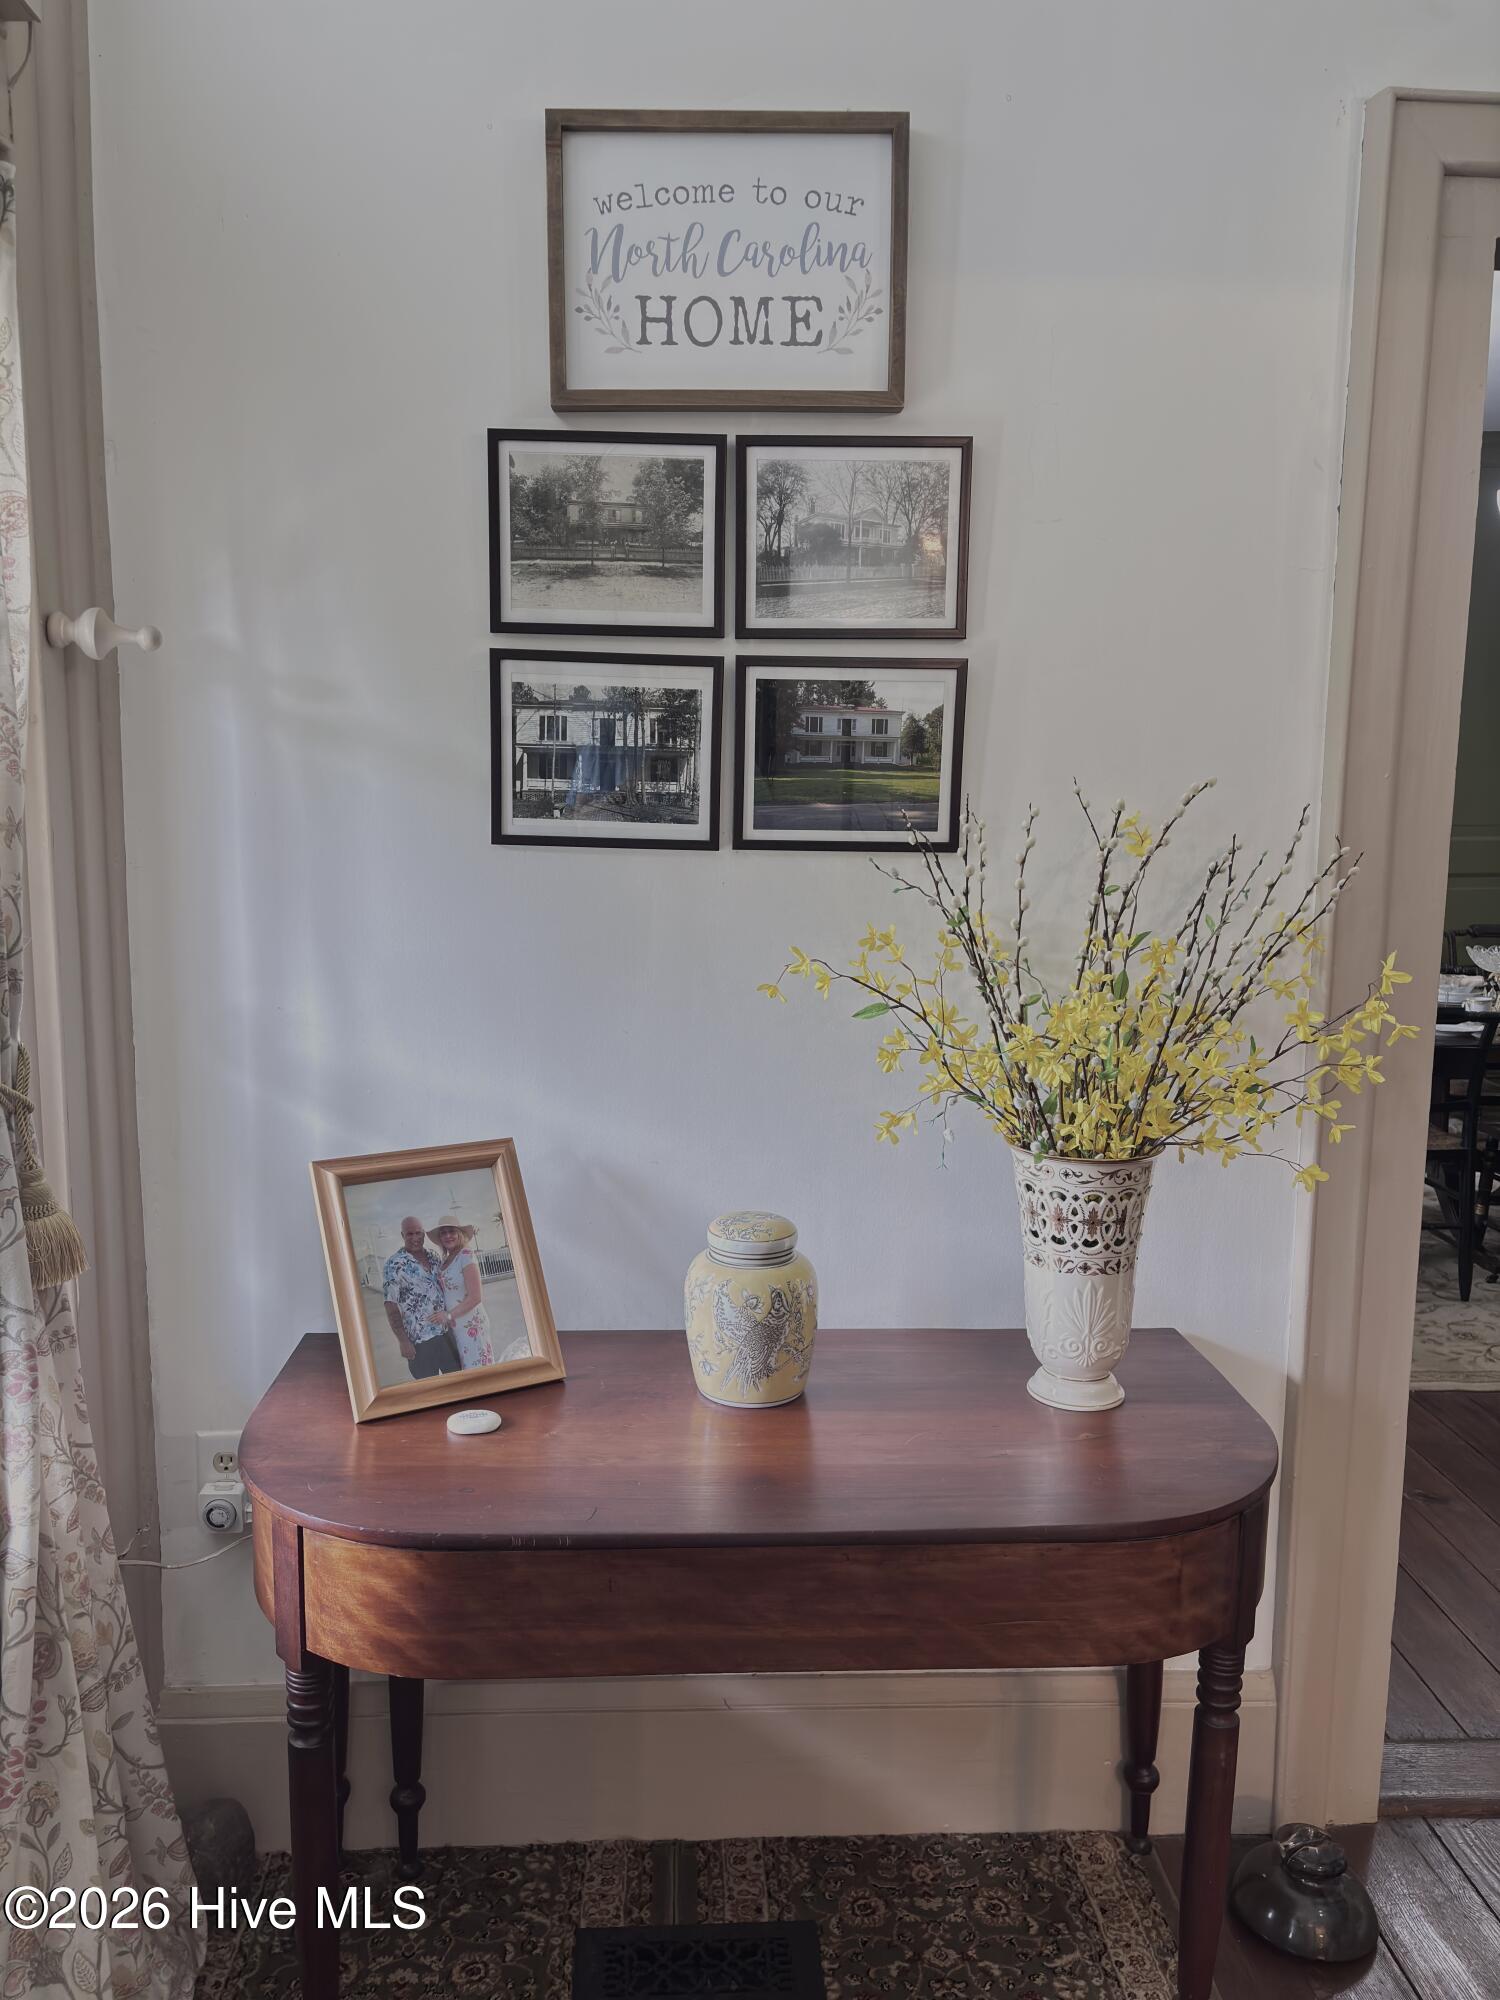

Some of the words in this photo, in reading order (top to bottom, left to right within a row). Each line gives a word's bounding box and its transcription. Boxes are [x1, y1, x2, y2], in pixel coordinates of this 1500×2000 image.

[592, 183, 735, 216] welcome
[752, 177, 787, 206] to
[804, 190, 865, 216] our
[584, 221, 710, 283] North
[716, 221, 873, 278] Carolina
[635, 295, 823, 347] HOME
